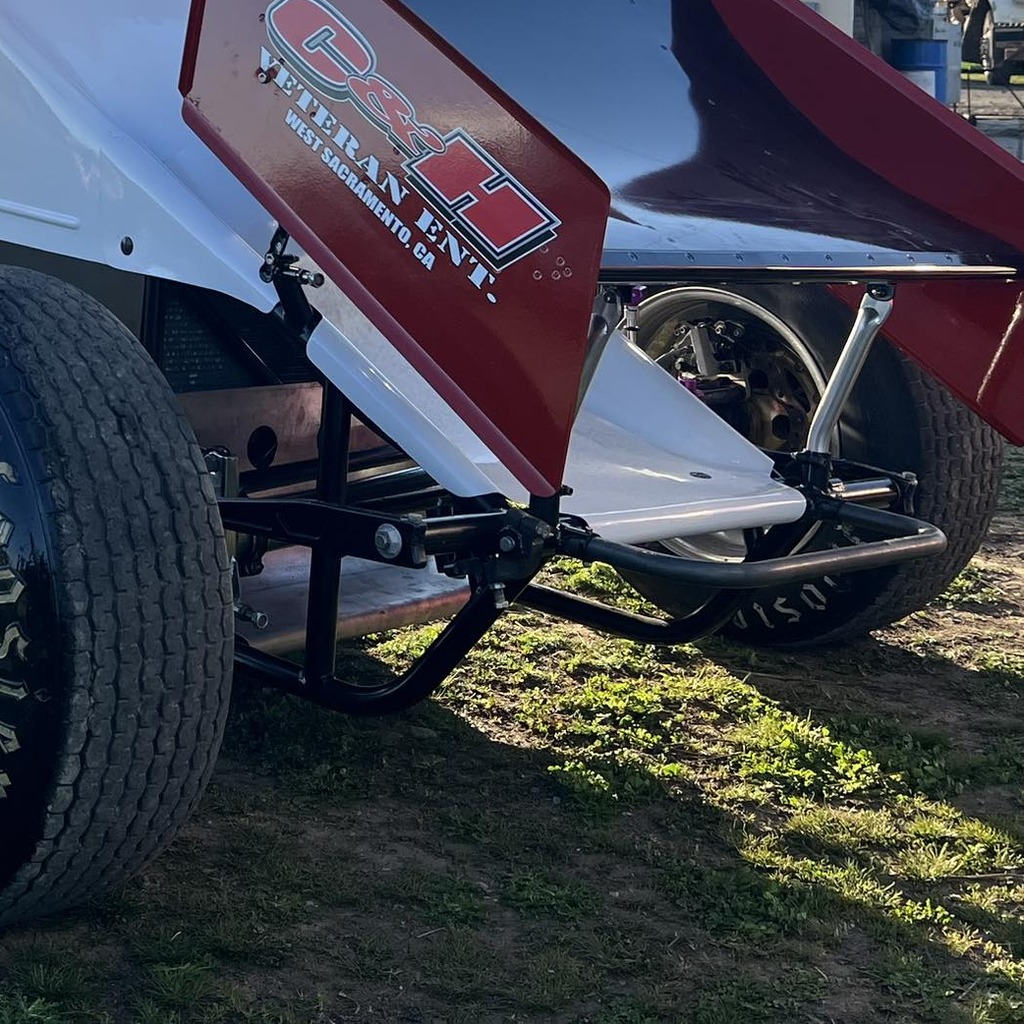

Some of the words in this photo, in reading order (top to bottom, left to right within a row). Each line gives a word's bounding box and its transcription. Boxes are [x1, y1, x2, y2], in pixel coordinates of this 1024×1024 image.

[260, 45, 411, 206] VETERAN
[414, 207, 498, 304] ENT.
[284, 108, 324, 152] WEST
[320, 146, 413, 248] SACRAMENTO,
[413, 240, 437, 271] CA
